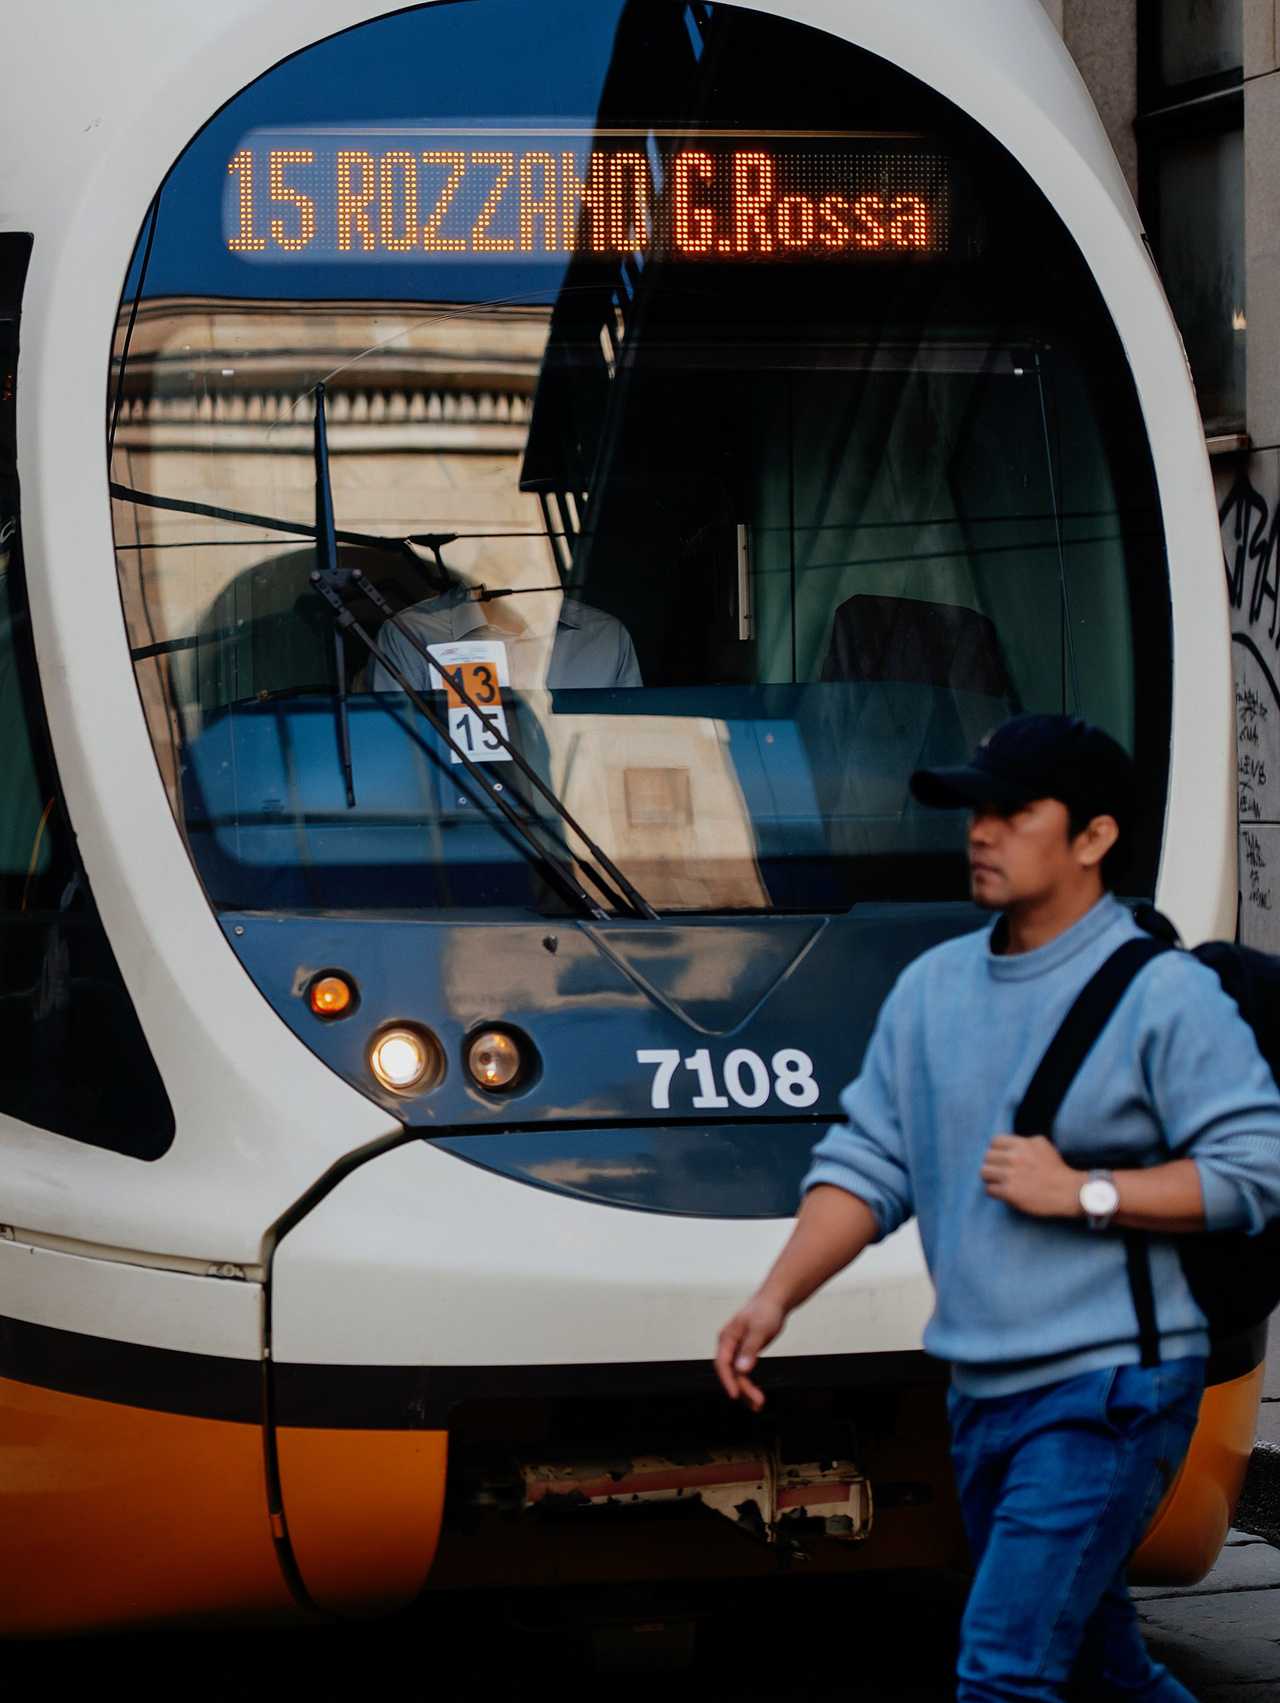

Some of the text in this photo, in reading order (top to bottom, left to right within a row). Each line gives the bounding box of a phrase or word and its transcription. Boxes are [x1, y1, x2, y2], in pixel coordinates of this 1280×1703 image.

[228, 151, 926, 251] 15 ROZZANO G.Rossa
[451, 666, 495, 704] 13
[456, 713, 503, 751] 15
[636, 1048, 820, 1109] 7108
